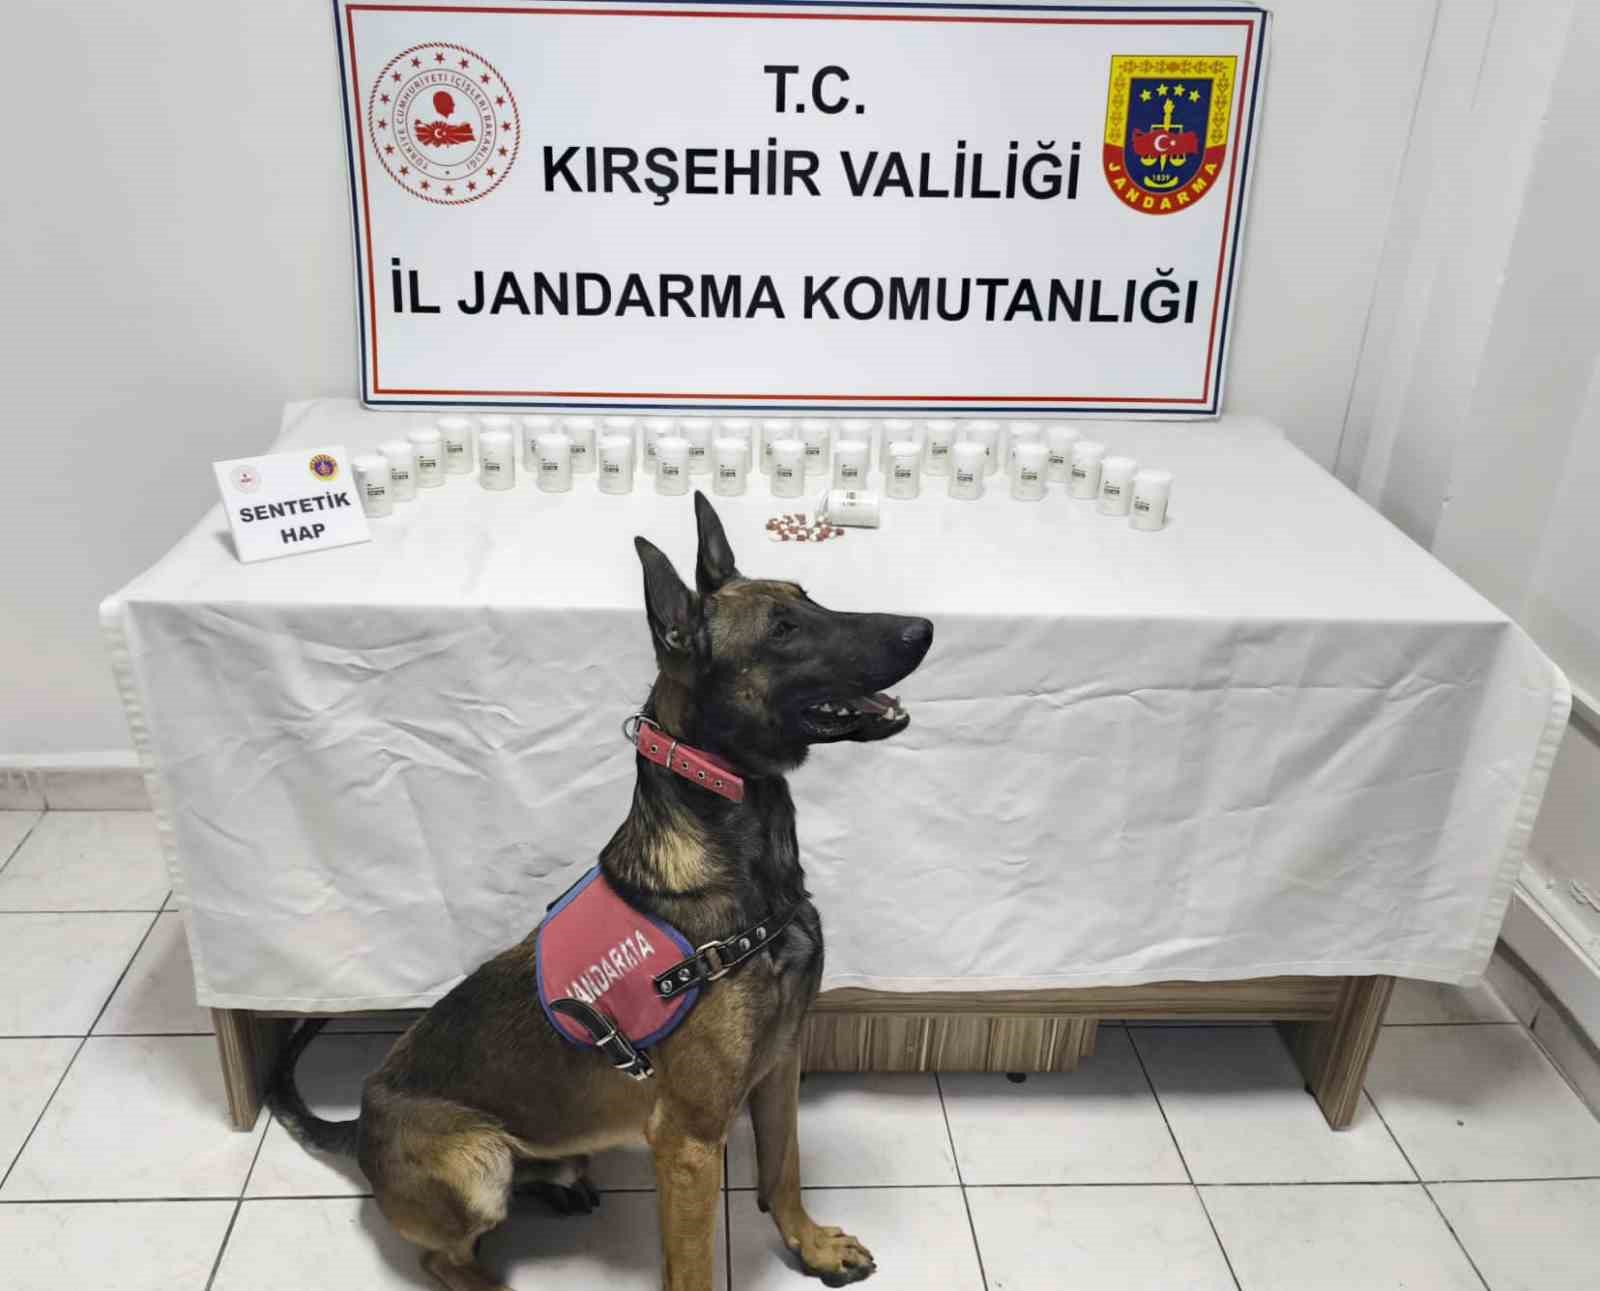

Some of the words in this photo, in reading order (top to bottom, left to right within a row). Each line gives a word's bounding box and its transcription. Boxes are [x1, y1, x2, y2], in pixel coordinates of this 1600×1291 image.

[764, 66, 865, 114] T.C.
[544, 138, 820, 205] KIRŞEHİR
[840, 141, 1080, 199] VALİLİĞİ
[1109, 163, 1217, 210] JANDARMA
[392, 258, 441, 314] İL
[458, 271, 785, 319] JANDARMA
[804, 268, 1197, 323] KOMUTANLIĞI
[240, 491, 351, 522] SENTETİK
[281, 523, 325, 544] HAP
